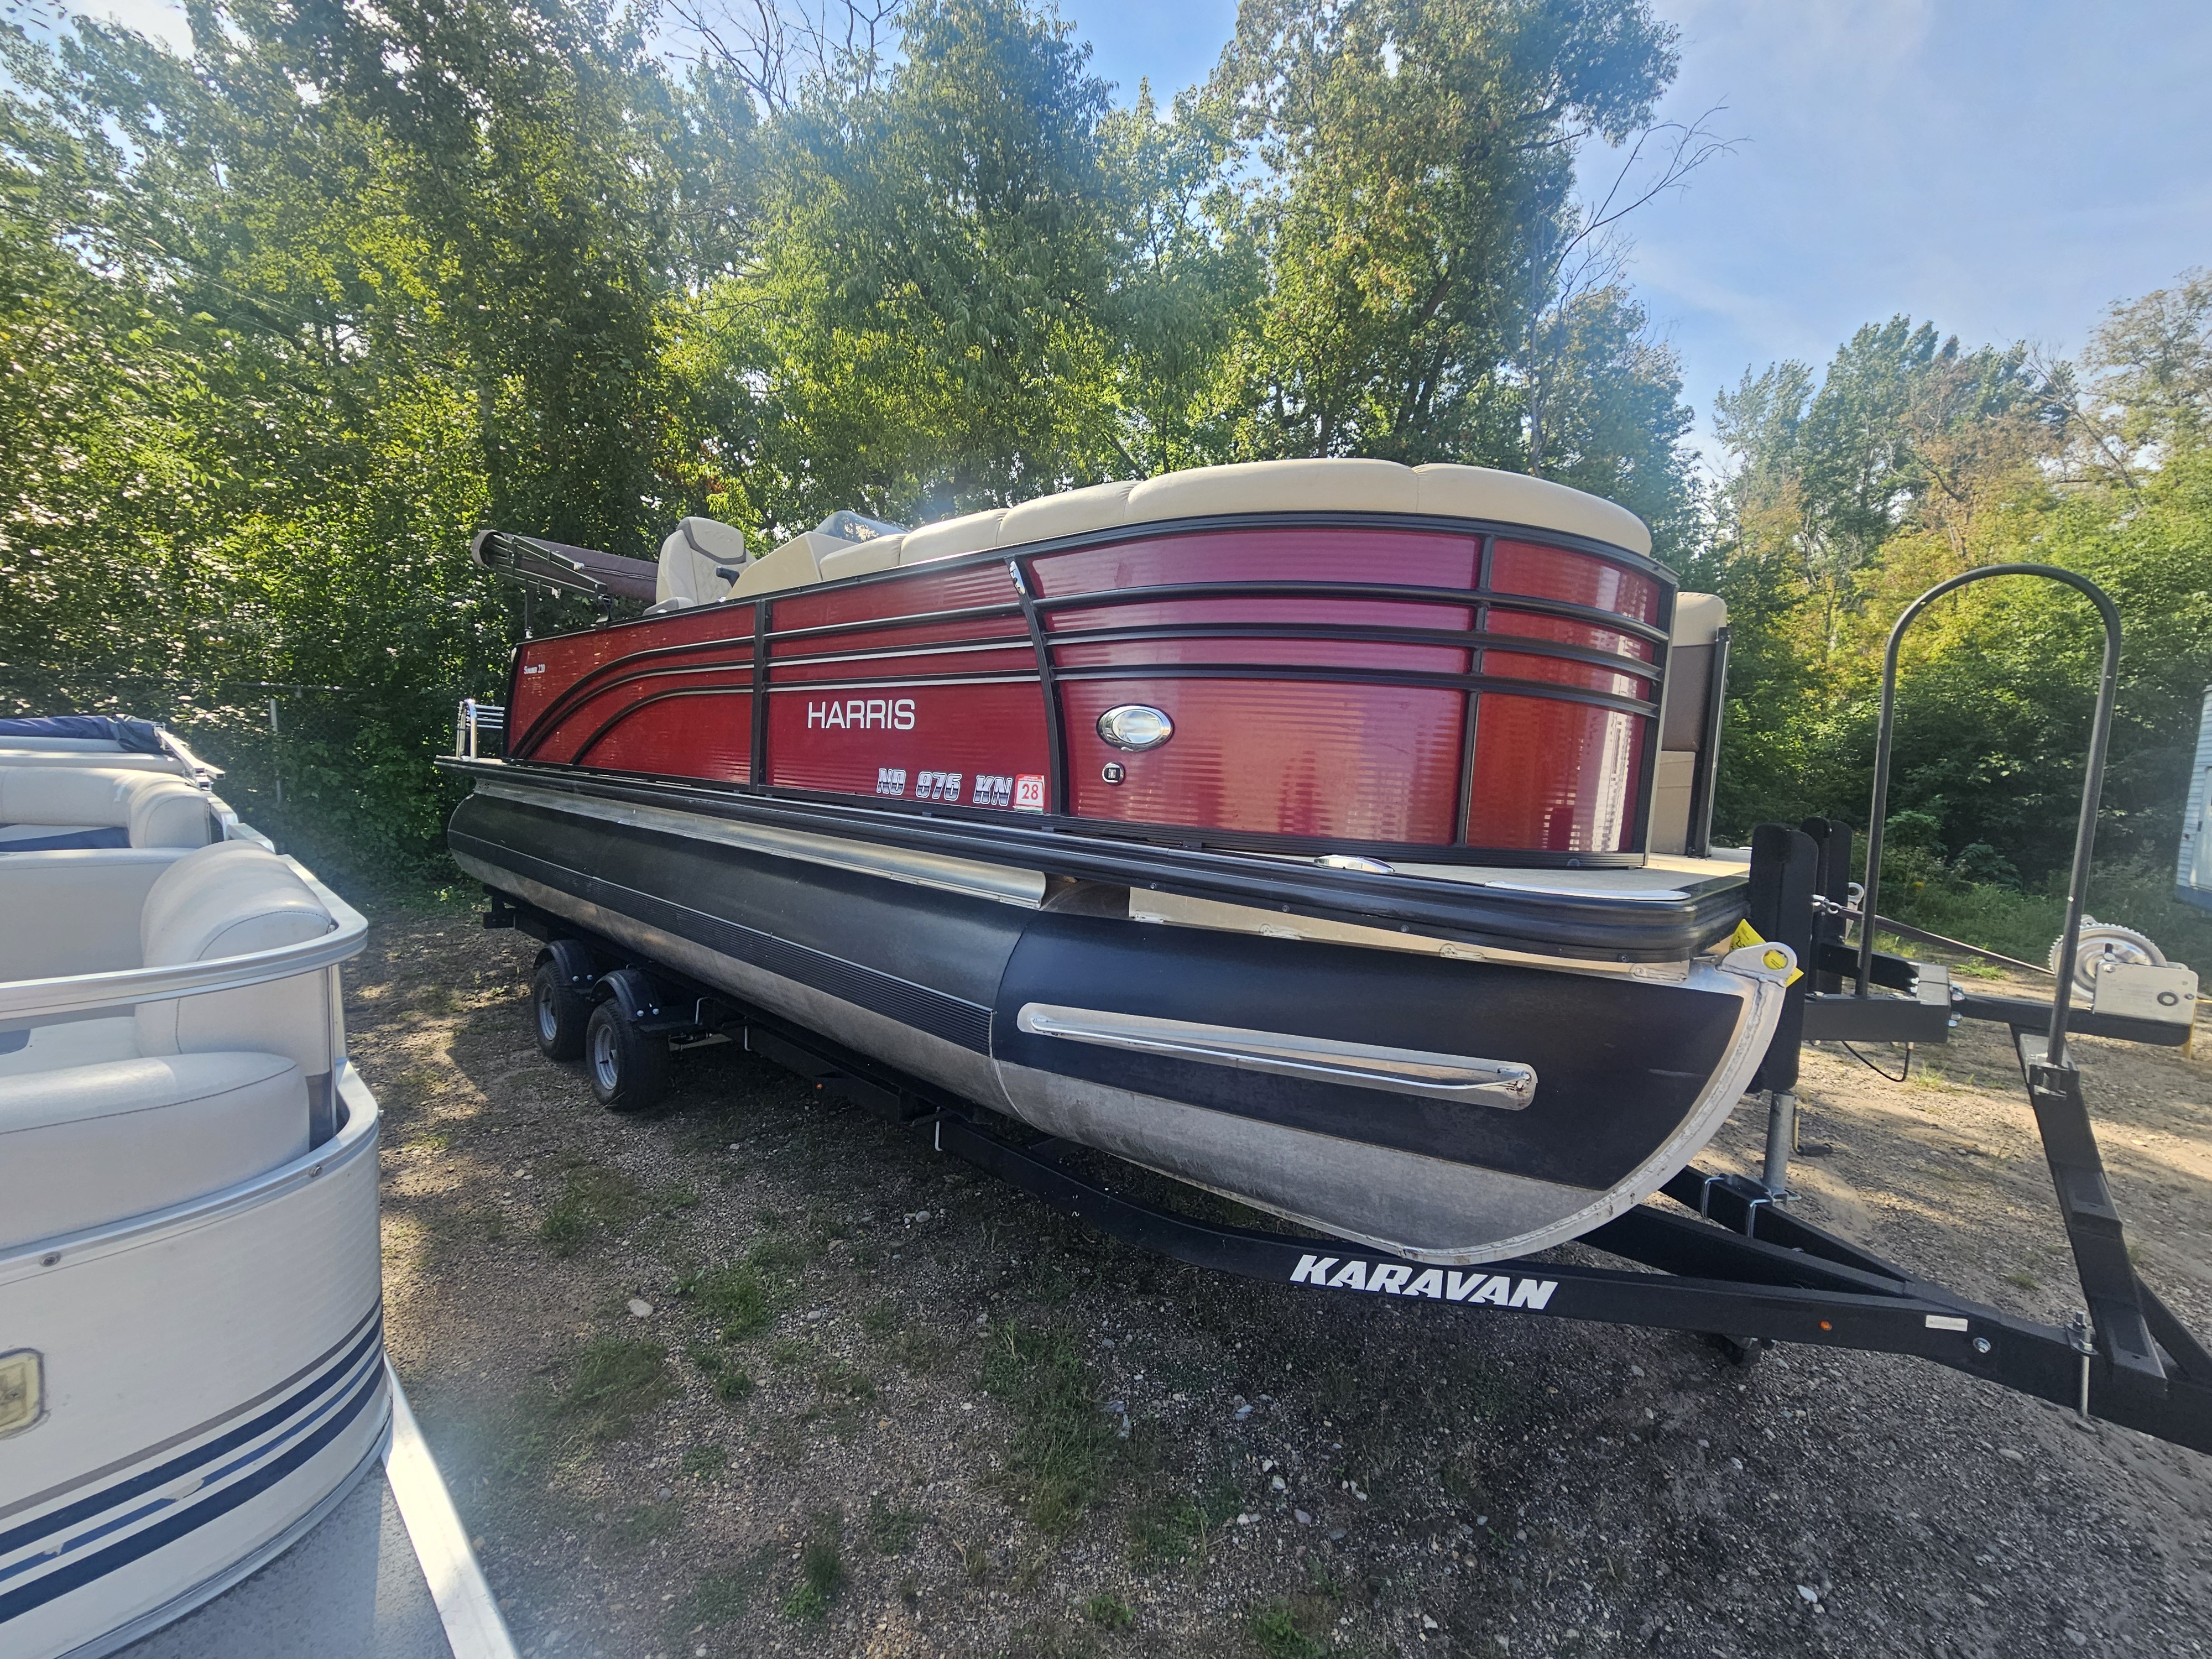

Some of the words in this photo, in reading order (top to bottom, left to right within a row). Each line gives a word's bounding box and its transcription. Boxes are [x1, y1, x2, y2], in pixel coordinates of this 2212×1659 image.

[807, 698, 916, 730] HARRIS
[877, 769, 906, 795] ND
[916, 772, 962, 801] 876
[973, 776, 1012, 806] KN
[1022, 783, 1039, 800] 28
[1290, 1254, 1558, 1310] KARAVAN
